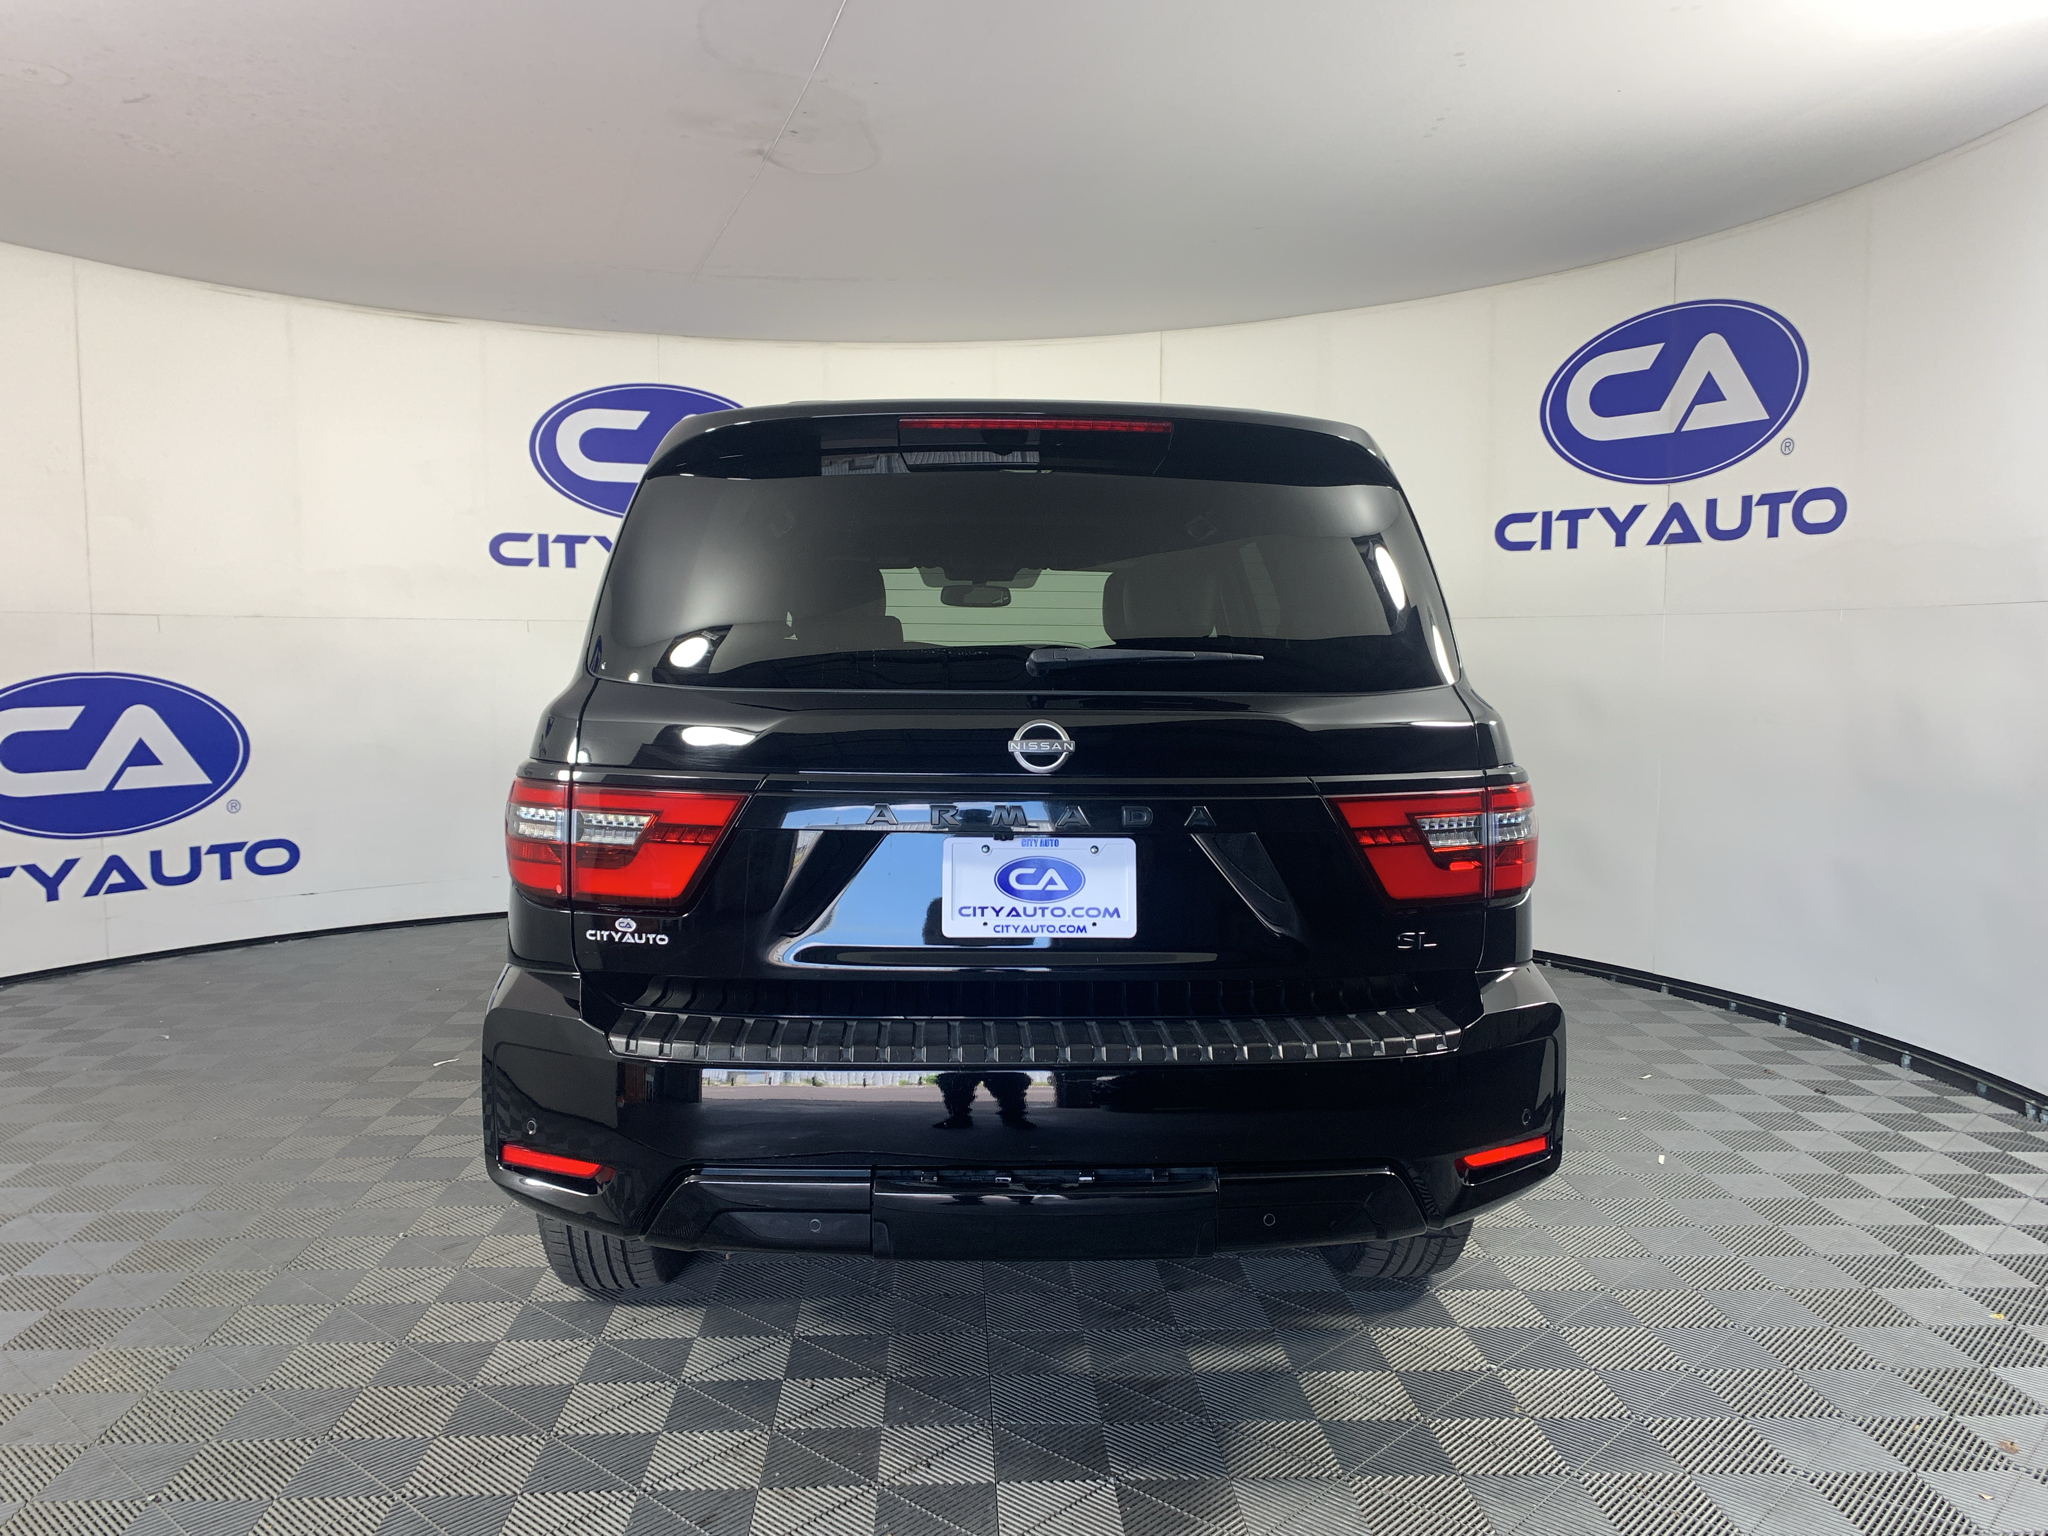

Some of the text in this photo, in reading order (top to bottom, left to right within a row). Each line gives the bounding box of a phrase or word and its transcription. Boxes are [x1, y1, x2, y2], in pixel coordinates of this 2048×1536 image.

[1566, 332, 1770, 441] CA
[1010, 741, 1074, 751] NISSAN
[866, 803, 1217, 827] ARMADA
[1020, 838, 1060, 848] CITY AUTO
[1008, 867, 1069, 891] CA
[958, 905, 1121, 919] CITYAUTO.COM
[993, 924, 1087, 934] CITYAUTO.COM
[1397, 931, 1438, 950] SL
